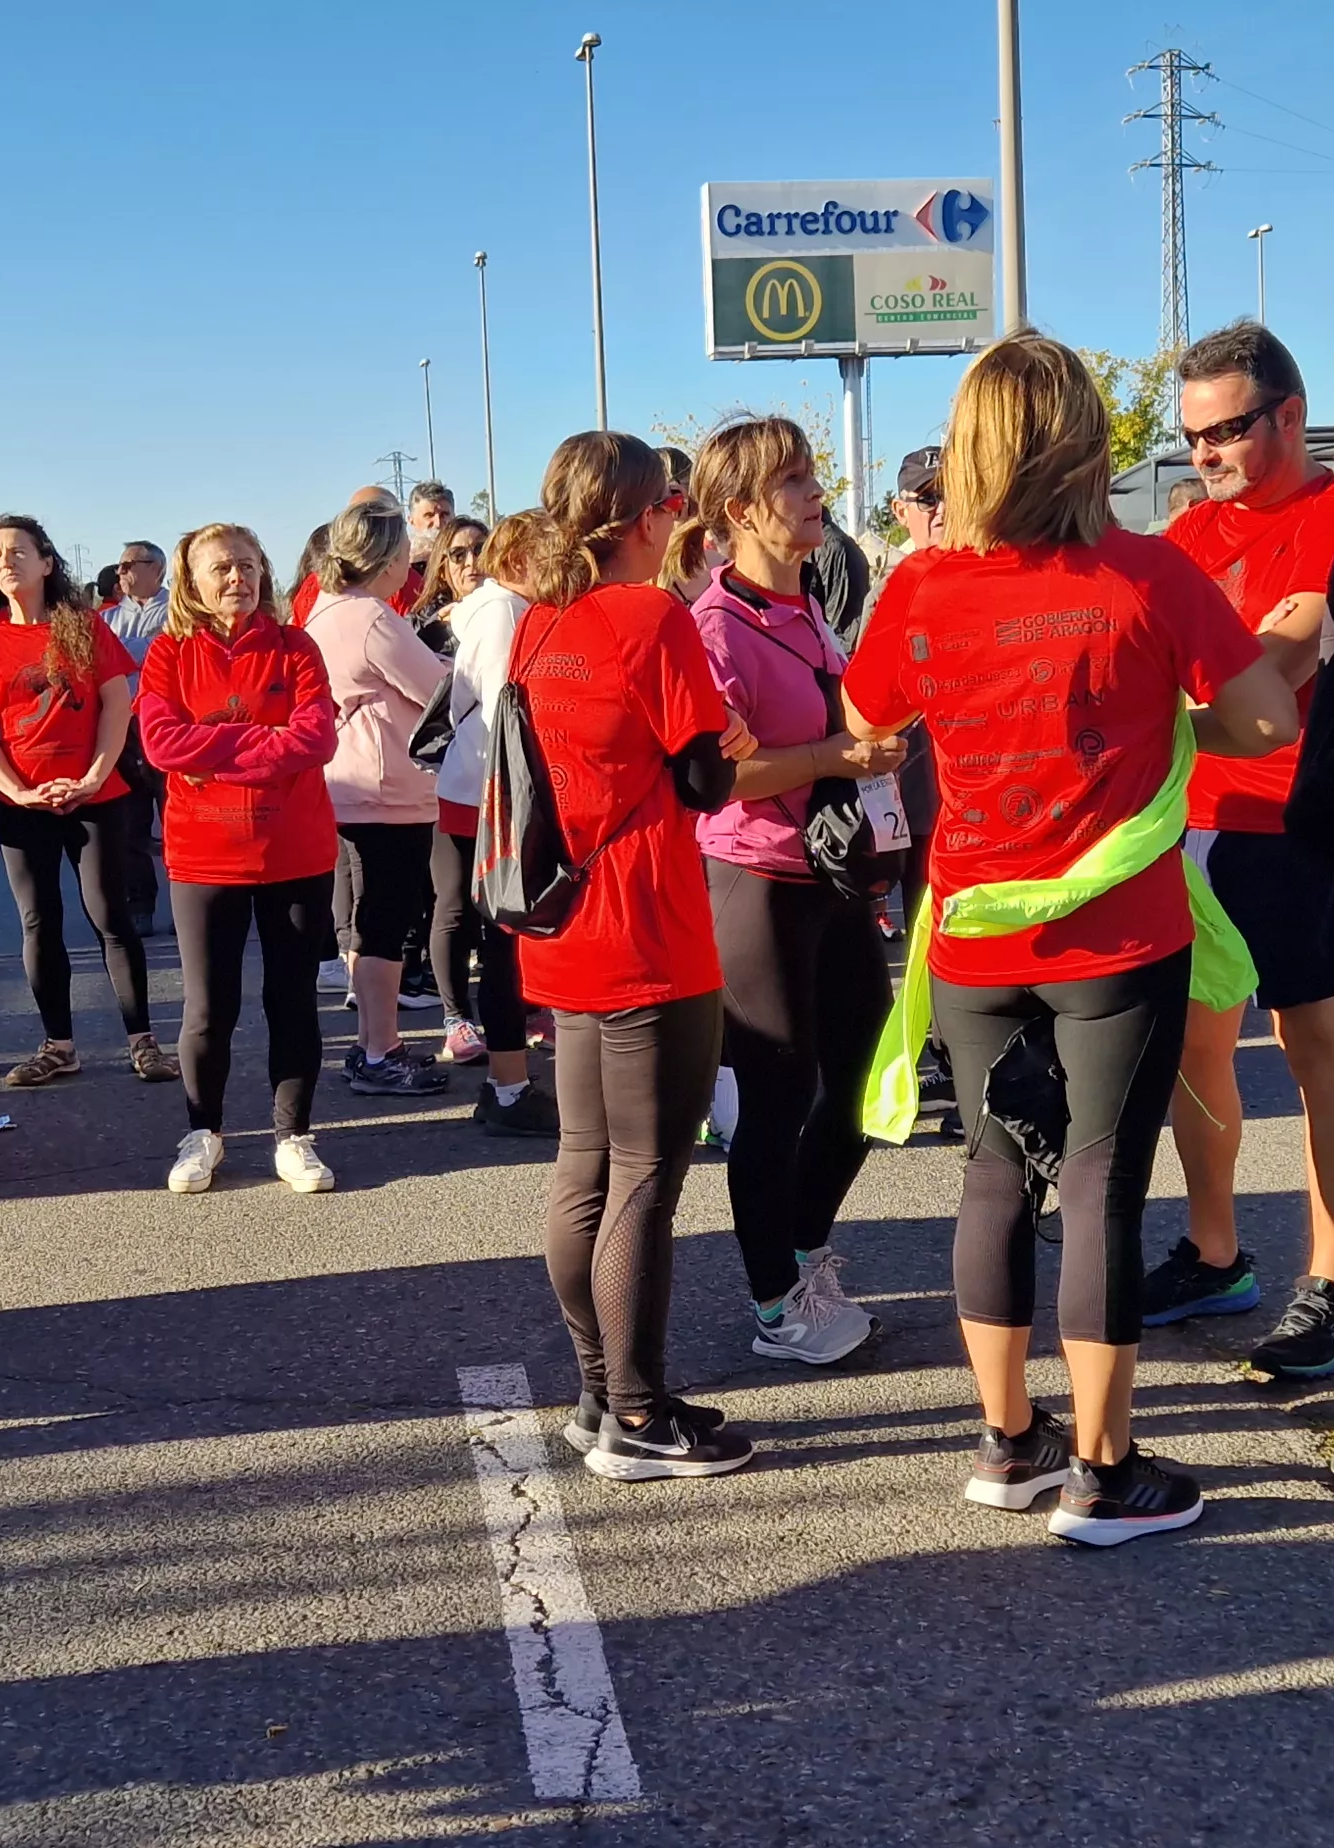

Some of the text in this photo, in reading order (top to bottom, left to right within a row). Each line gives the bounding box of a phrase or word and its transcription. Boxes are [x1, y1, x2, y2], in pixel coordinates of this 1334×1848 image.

[717, 200, 899, 238] Carrefour
[870, 292, 979, 310] COSO REAL
[1022, 606, 1105, 629] GOBIERNO
[1023, 618, 1117, 643] DE ARAGON
[545, 665, 592, 682] ARAGON
[997, 689, 1105, 719] URBAN
